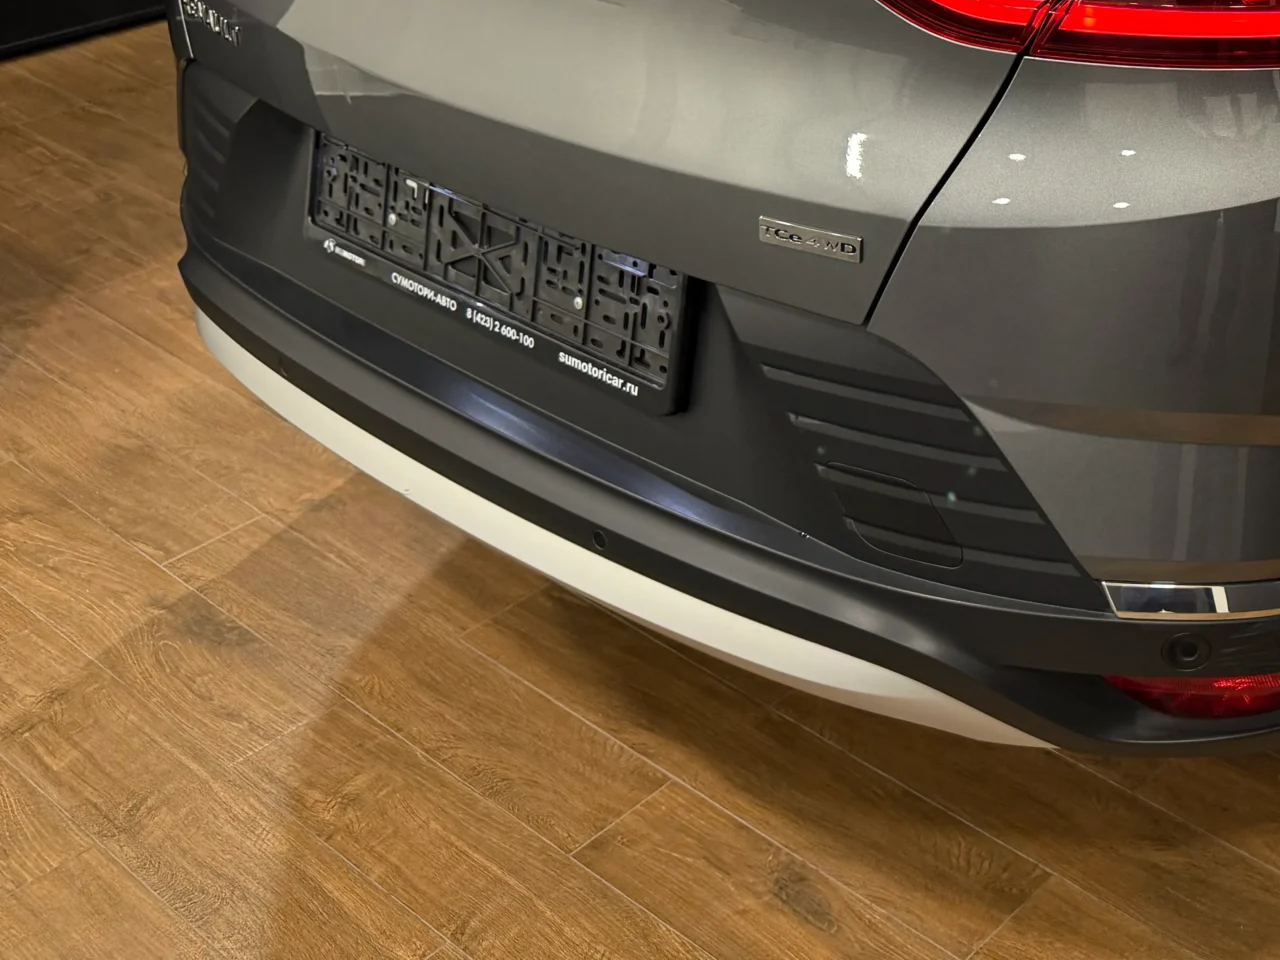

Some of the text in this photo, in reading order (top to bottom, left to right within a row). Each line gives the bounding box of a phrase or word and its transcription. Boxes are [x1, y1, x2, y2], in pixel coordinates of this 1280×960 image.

[391, 271, 535, 349] СУМОТОРИ-АВТО 8 (423) 2 600-100
[558, 350, 639, 397] sumotoricar.ru
